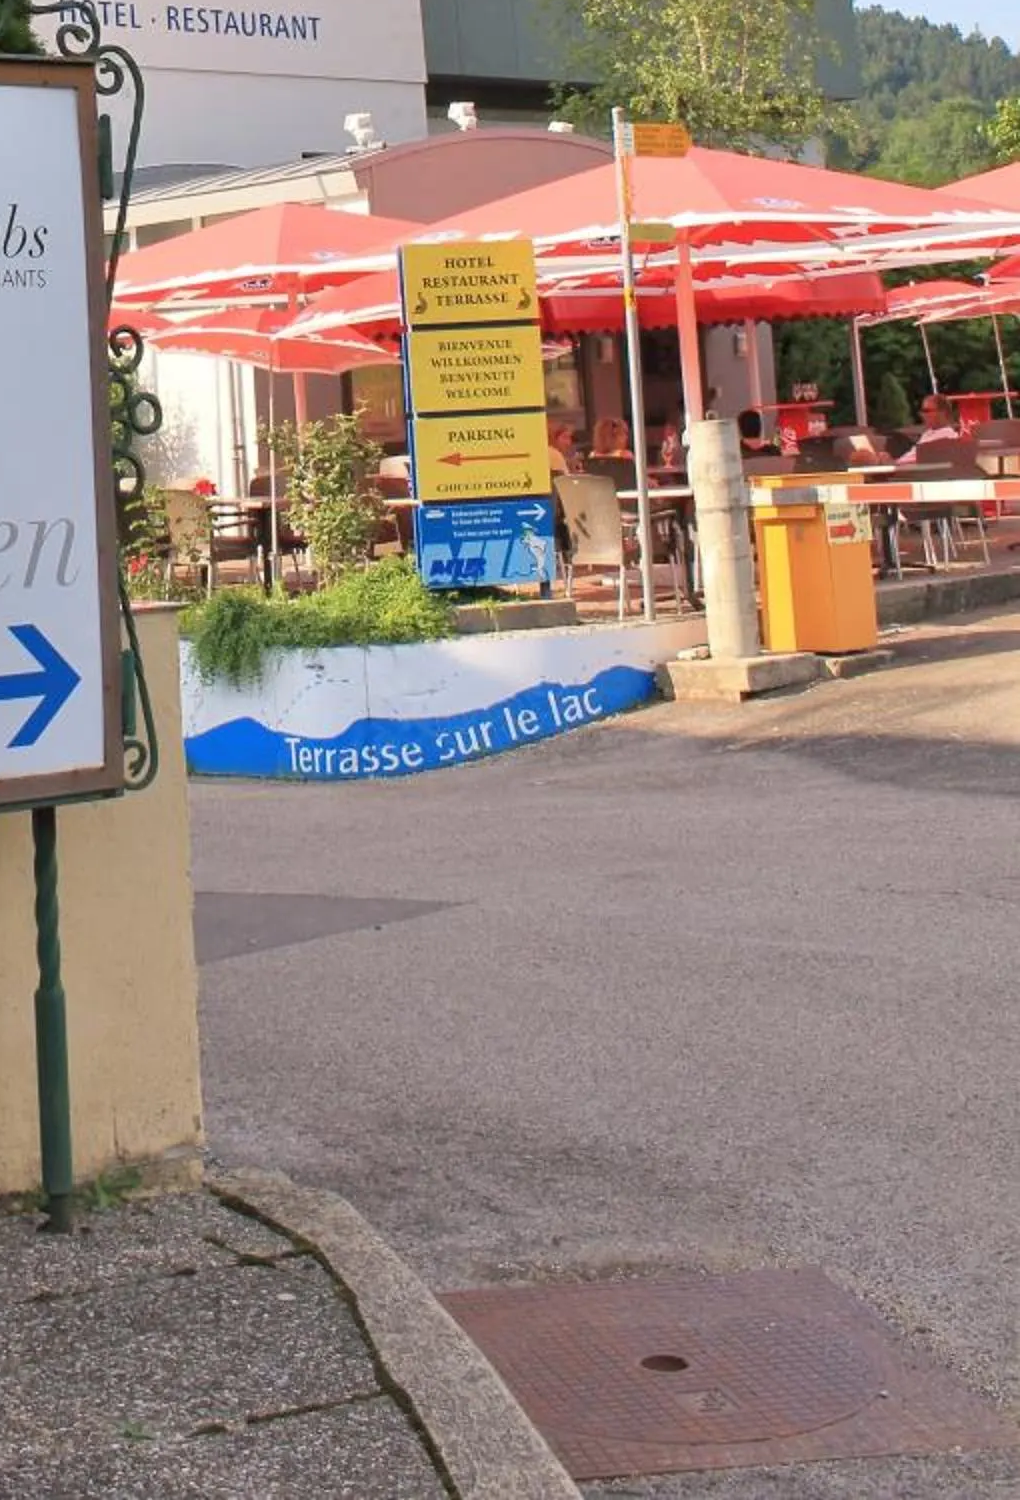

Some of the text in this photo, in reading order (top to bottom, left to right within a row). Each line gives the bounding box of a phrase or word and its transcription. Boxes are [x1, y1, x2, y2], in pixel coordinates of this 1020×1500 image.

[167, 5, 321, 41] RESTAURANT
[445, 256, 495, 269] HOTEL
[423, 274, 519, 288] RESTAURANT
[436, 293, 508, 306] TERRASSE
[438, 340, 512, 351] BIENVENUE
[431, 355, 521, 368] WILLKOMMEN
[439, 371, 515, 384] BENVENUTI
[445, 386, 511, 399] WELCOME
[448, 428, 515, 443] PARKING
[285, 686, 602, 774] Terrasse sur le lac
